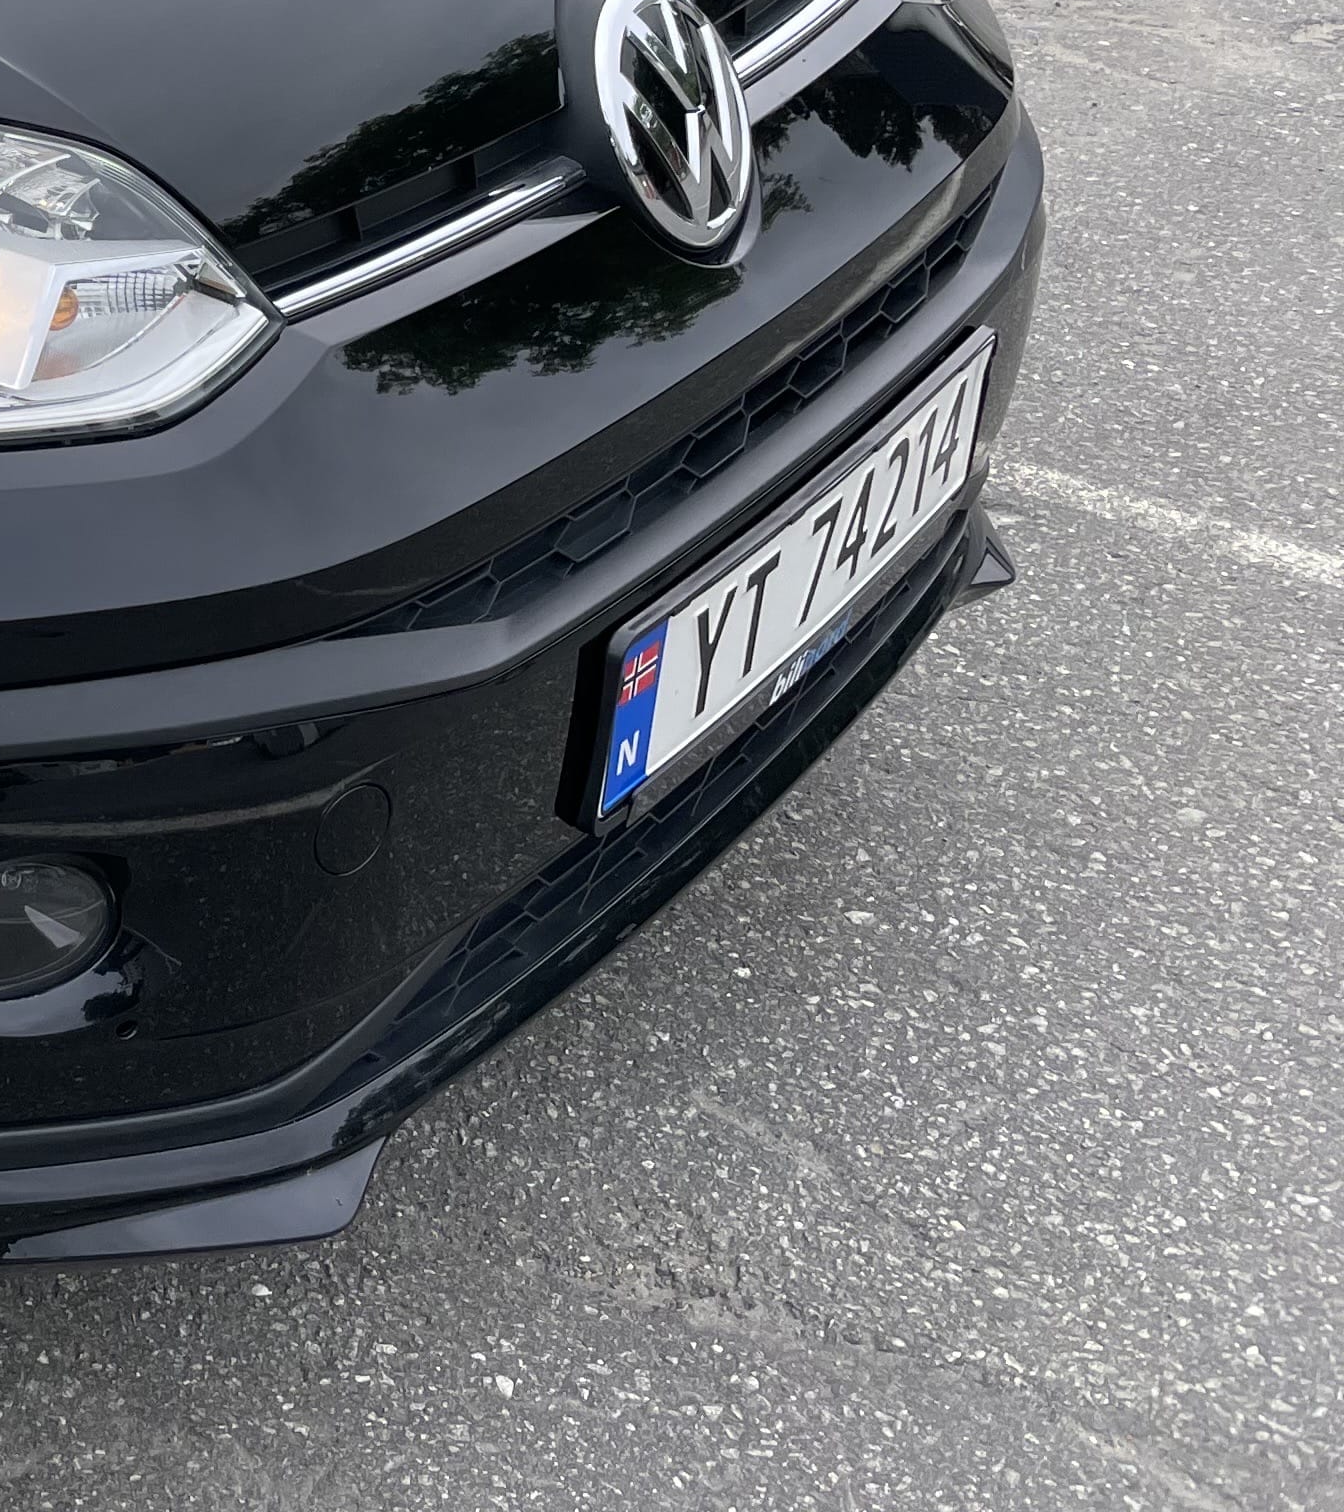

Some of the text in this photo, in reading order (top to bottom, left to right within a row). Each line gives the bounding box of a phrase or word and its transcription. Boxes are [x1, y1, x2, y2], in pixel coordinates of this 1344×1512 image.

[693, 377, 969, 720] YT 74214
[615, 728, 641, 777] N
